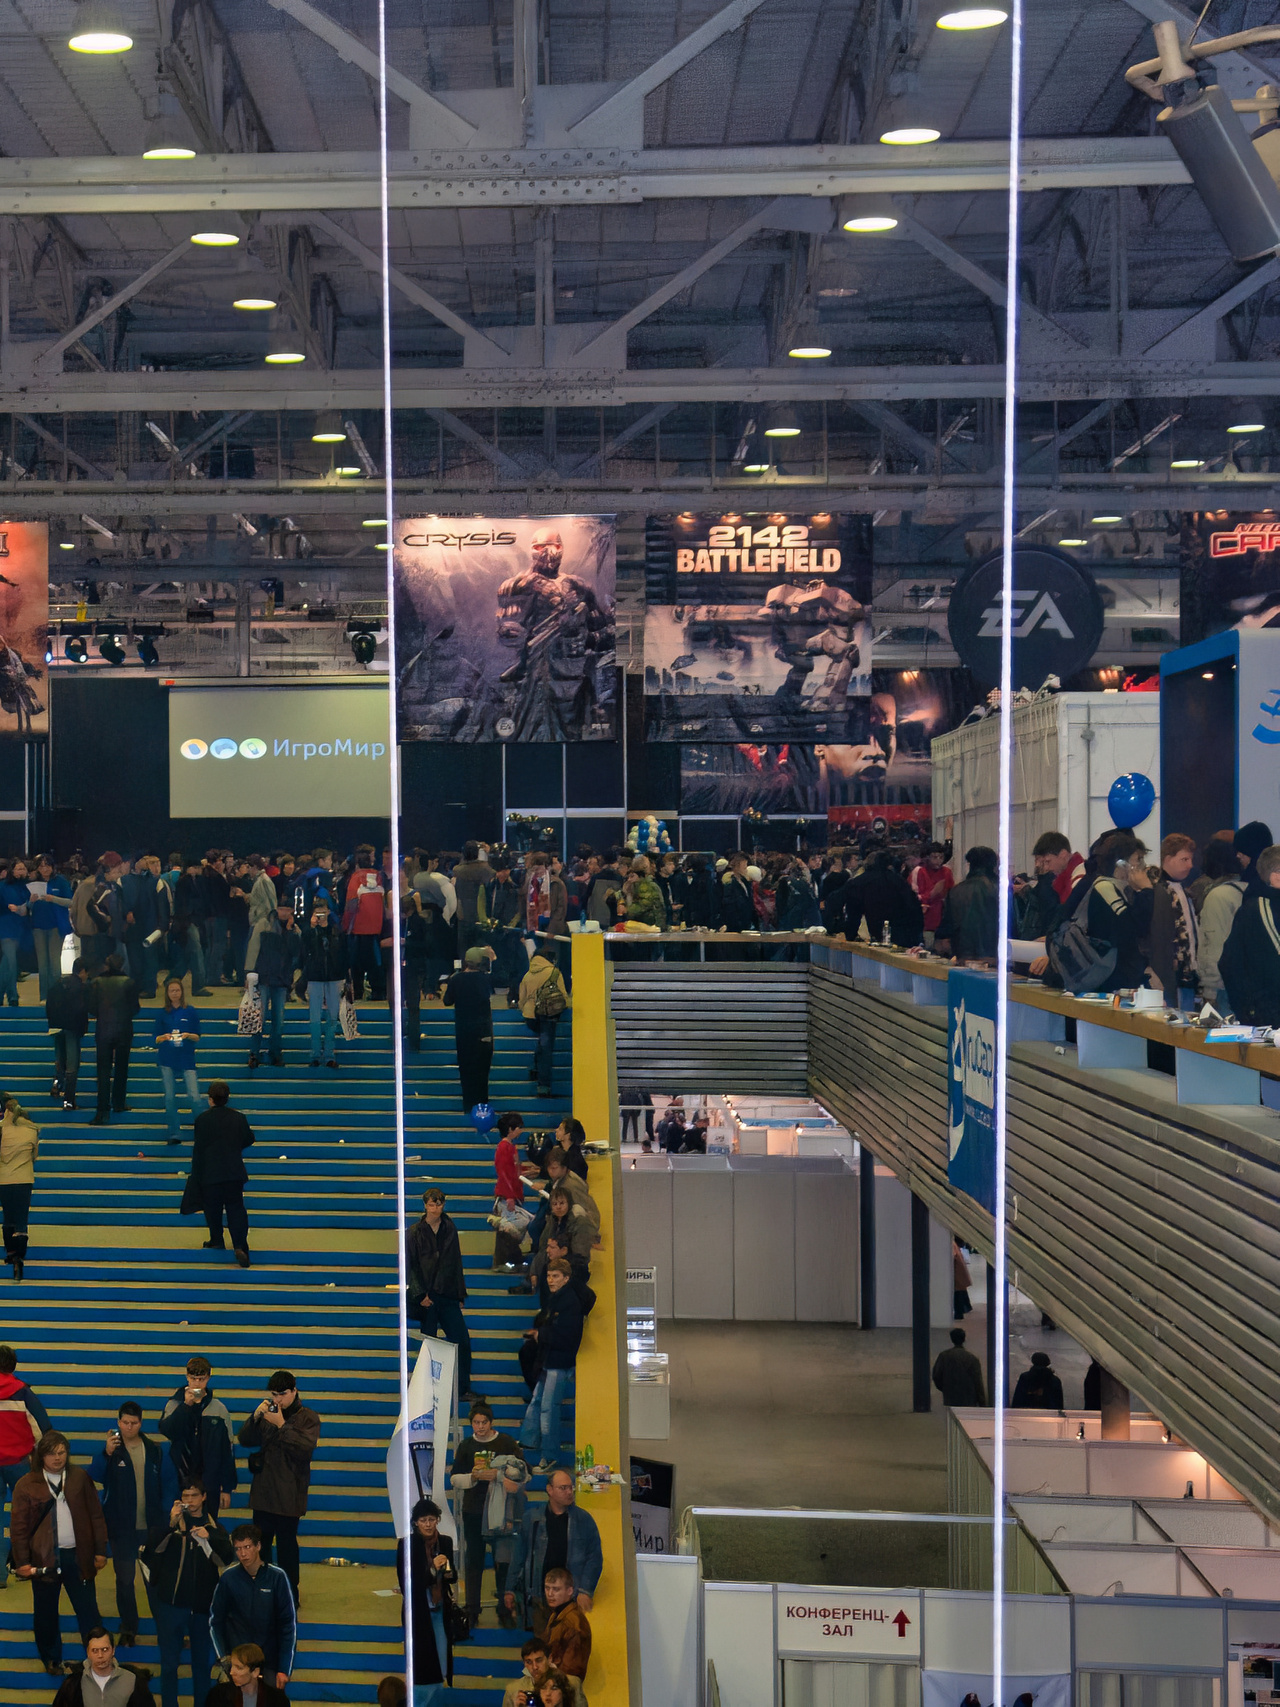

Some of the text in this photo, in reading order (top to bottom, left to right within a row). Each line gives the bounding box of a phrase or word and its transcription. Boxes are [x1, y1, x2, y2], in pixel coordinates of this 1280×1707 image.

[708, 525, 809, 548] 2142
[676, 548, 842, 573] BATTLEFIELD
[977, 589, 1075, 639] EA
[273, 738, 386, 761] ИгроМир
[786, 1605, 890, 1623] КОНФЕРЕНЦ-
[822, 1624, 853, 1636] ЗАЛ
